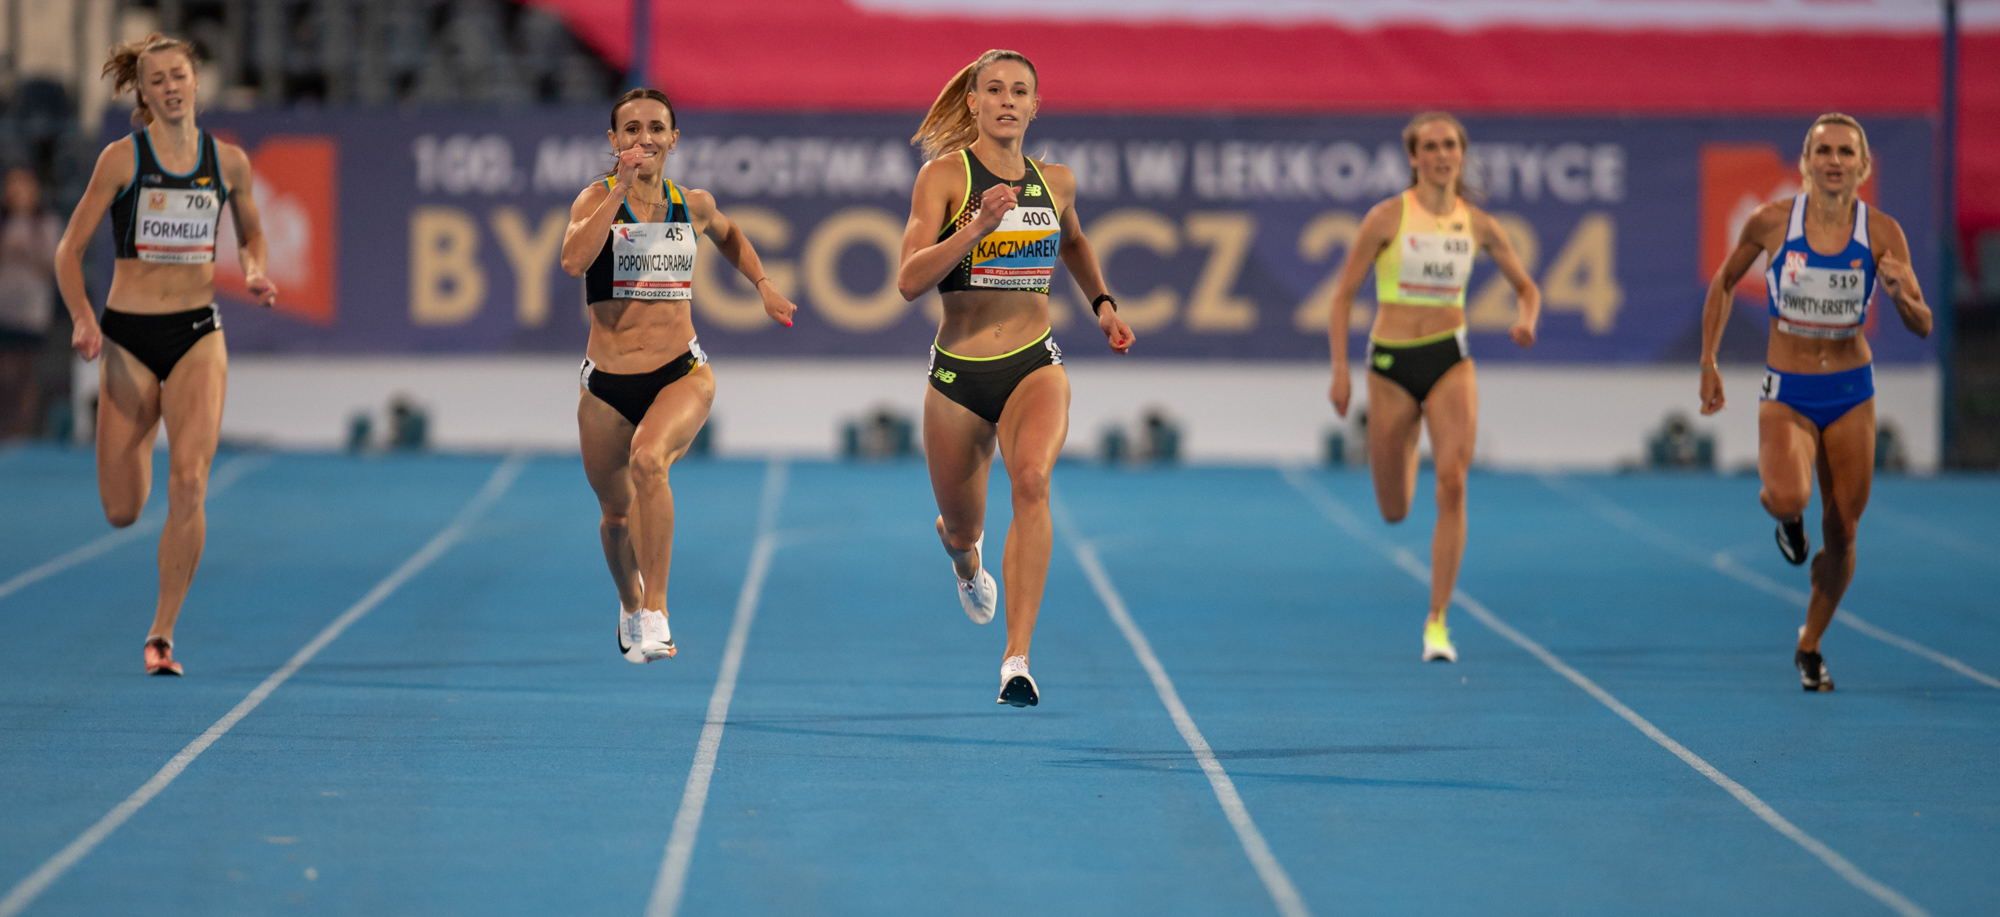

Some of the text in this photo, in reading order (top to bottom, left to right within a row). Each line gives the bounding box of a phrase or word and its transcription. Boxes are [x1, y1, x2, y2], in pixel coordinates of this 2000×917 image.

[185, 194, 212, 209] 709
[1022, 211, 1050, 226] 400
[143, 220, 208, 239] FORMELLA
[665, 227, 684, 241] 45
[977, 239, 1057, 258] KACZMAREK
[618, 254, 693, 272] POPOWICZ-DRAPAŁA
[1293, 211, 1625, 335] 224
[983, 277, 1031, 286] BYDGOSZCZ
[1828, 274, 1858, 288] 519
[624, 289, 671, 298] BYDGOSZCZ
